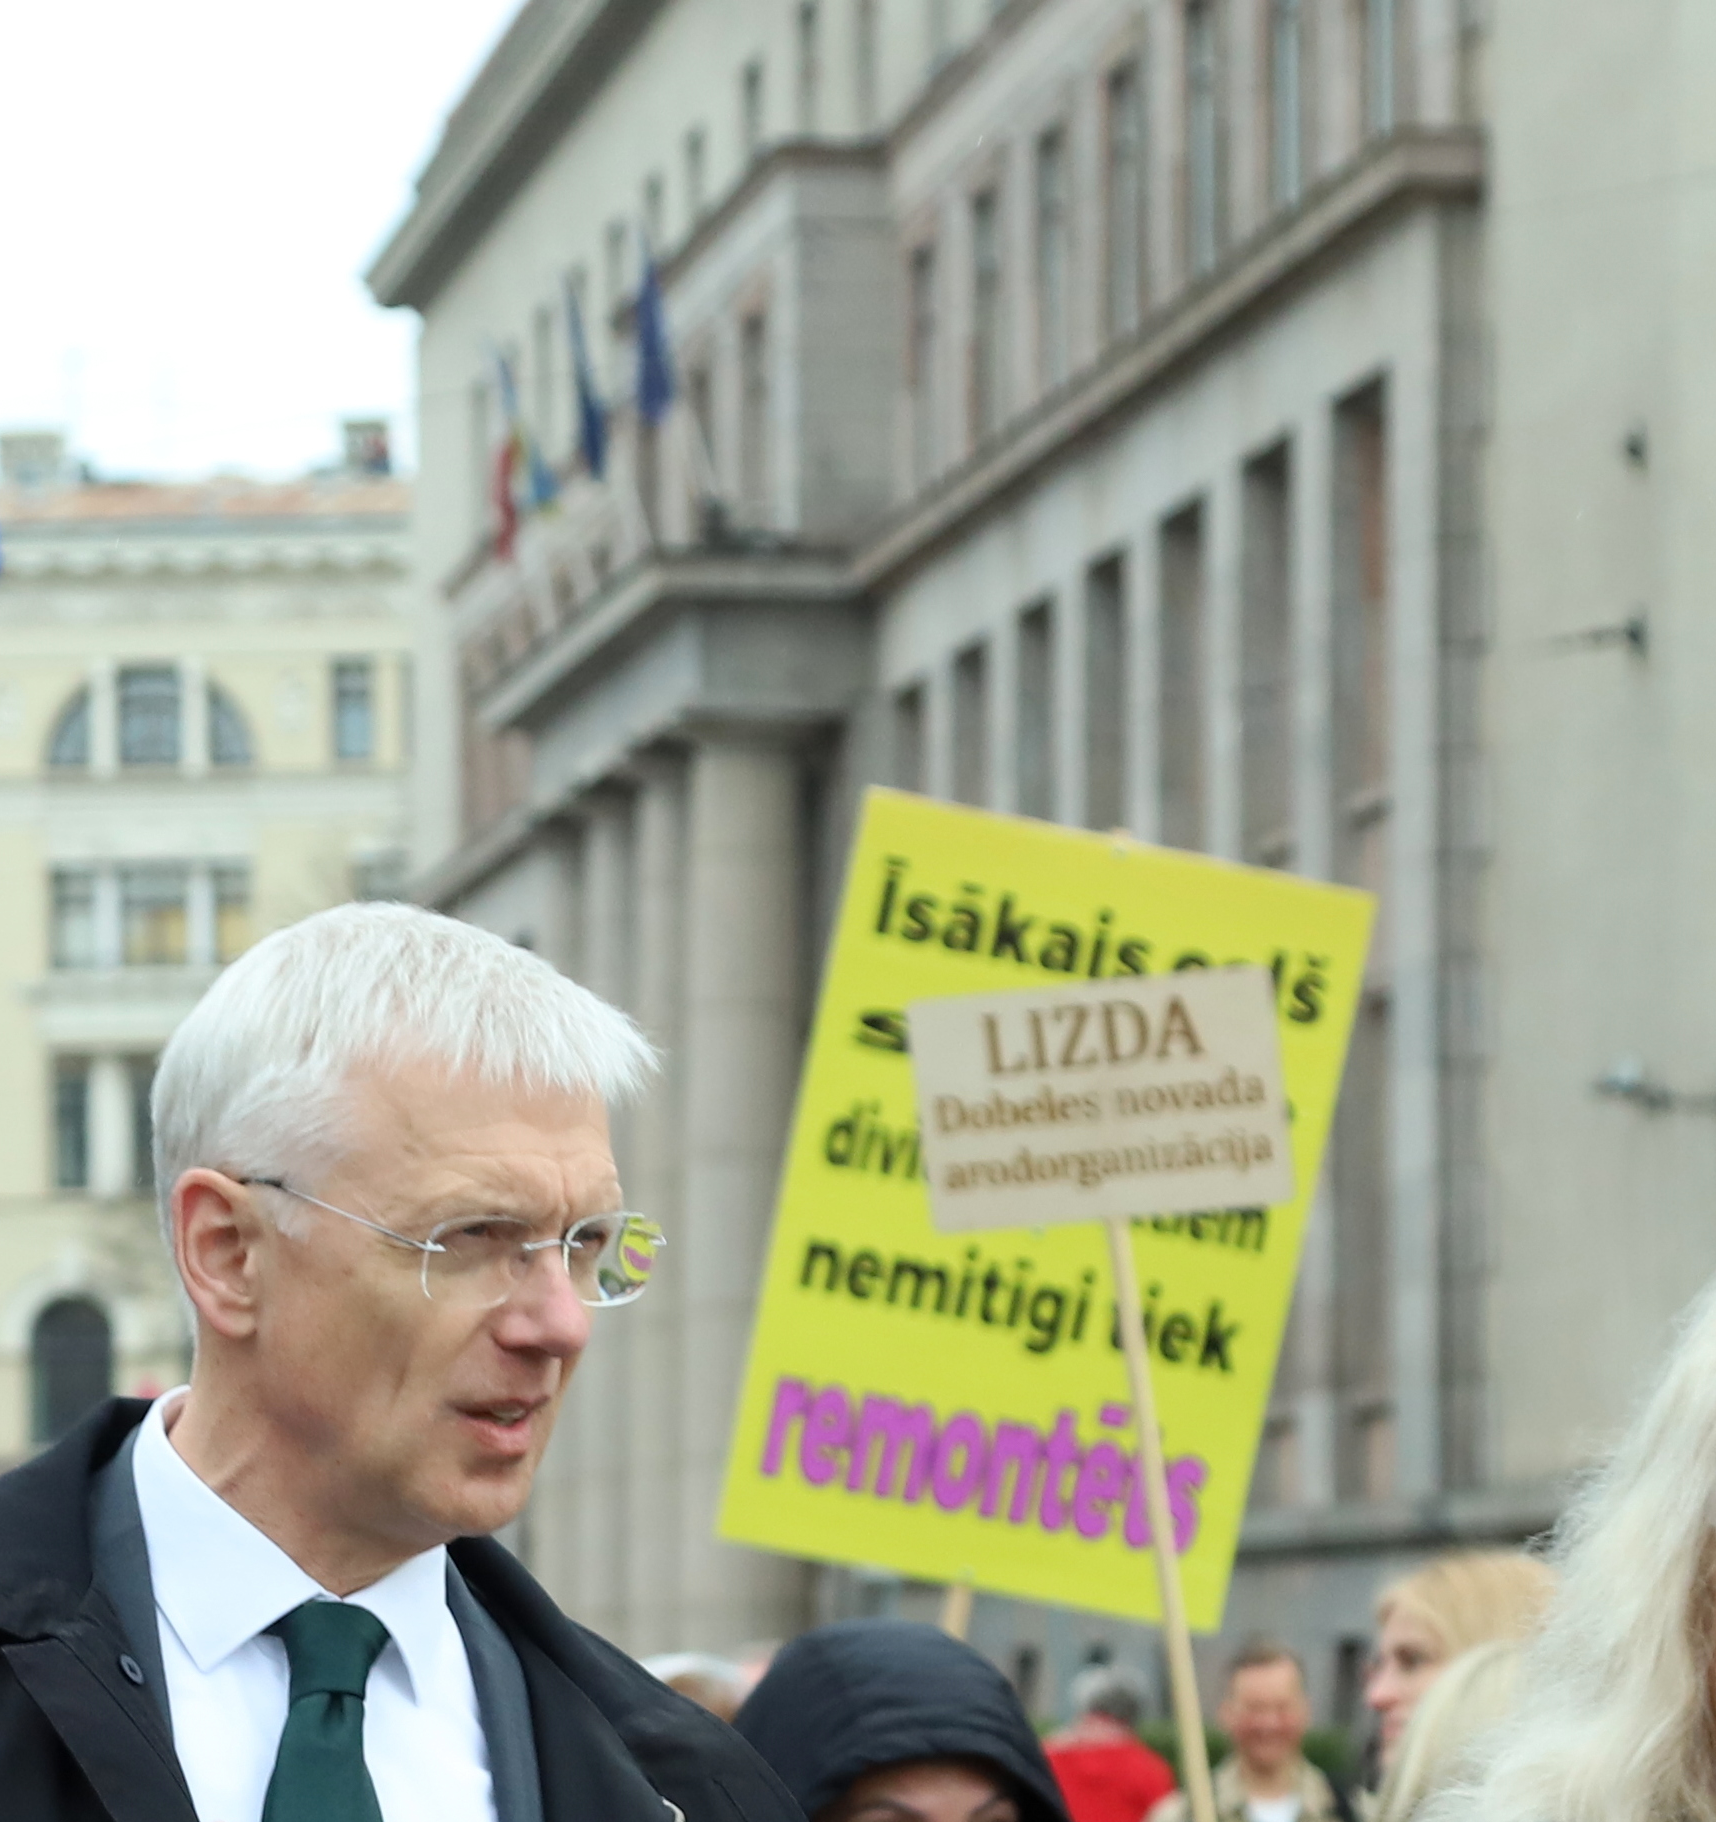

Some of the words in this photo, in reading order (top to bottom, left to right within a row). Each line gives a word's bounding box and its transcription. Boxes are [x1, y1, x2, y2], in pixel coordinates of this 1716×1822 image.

[873, 857, 1151, 980] Īsākais
[980, 993, 1209, 1078] LIZDA
[1113, 1064, 1268, 1119] novada
[761, 1378, 1207, 1554] remontēts
